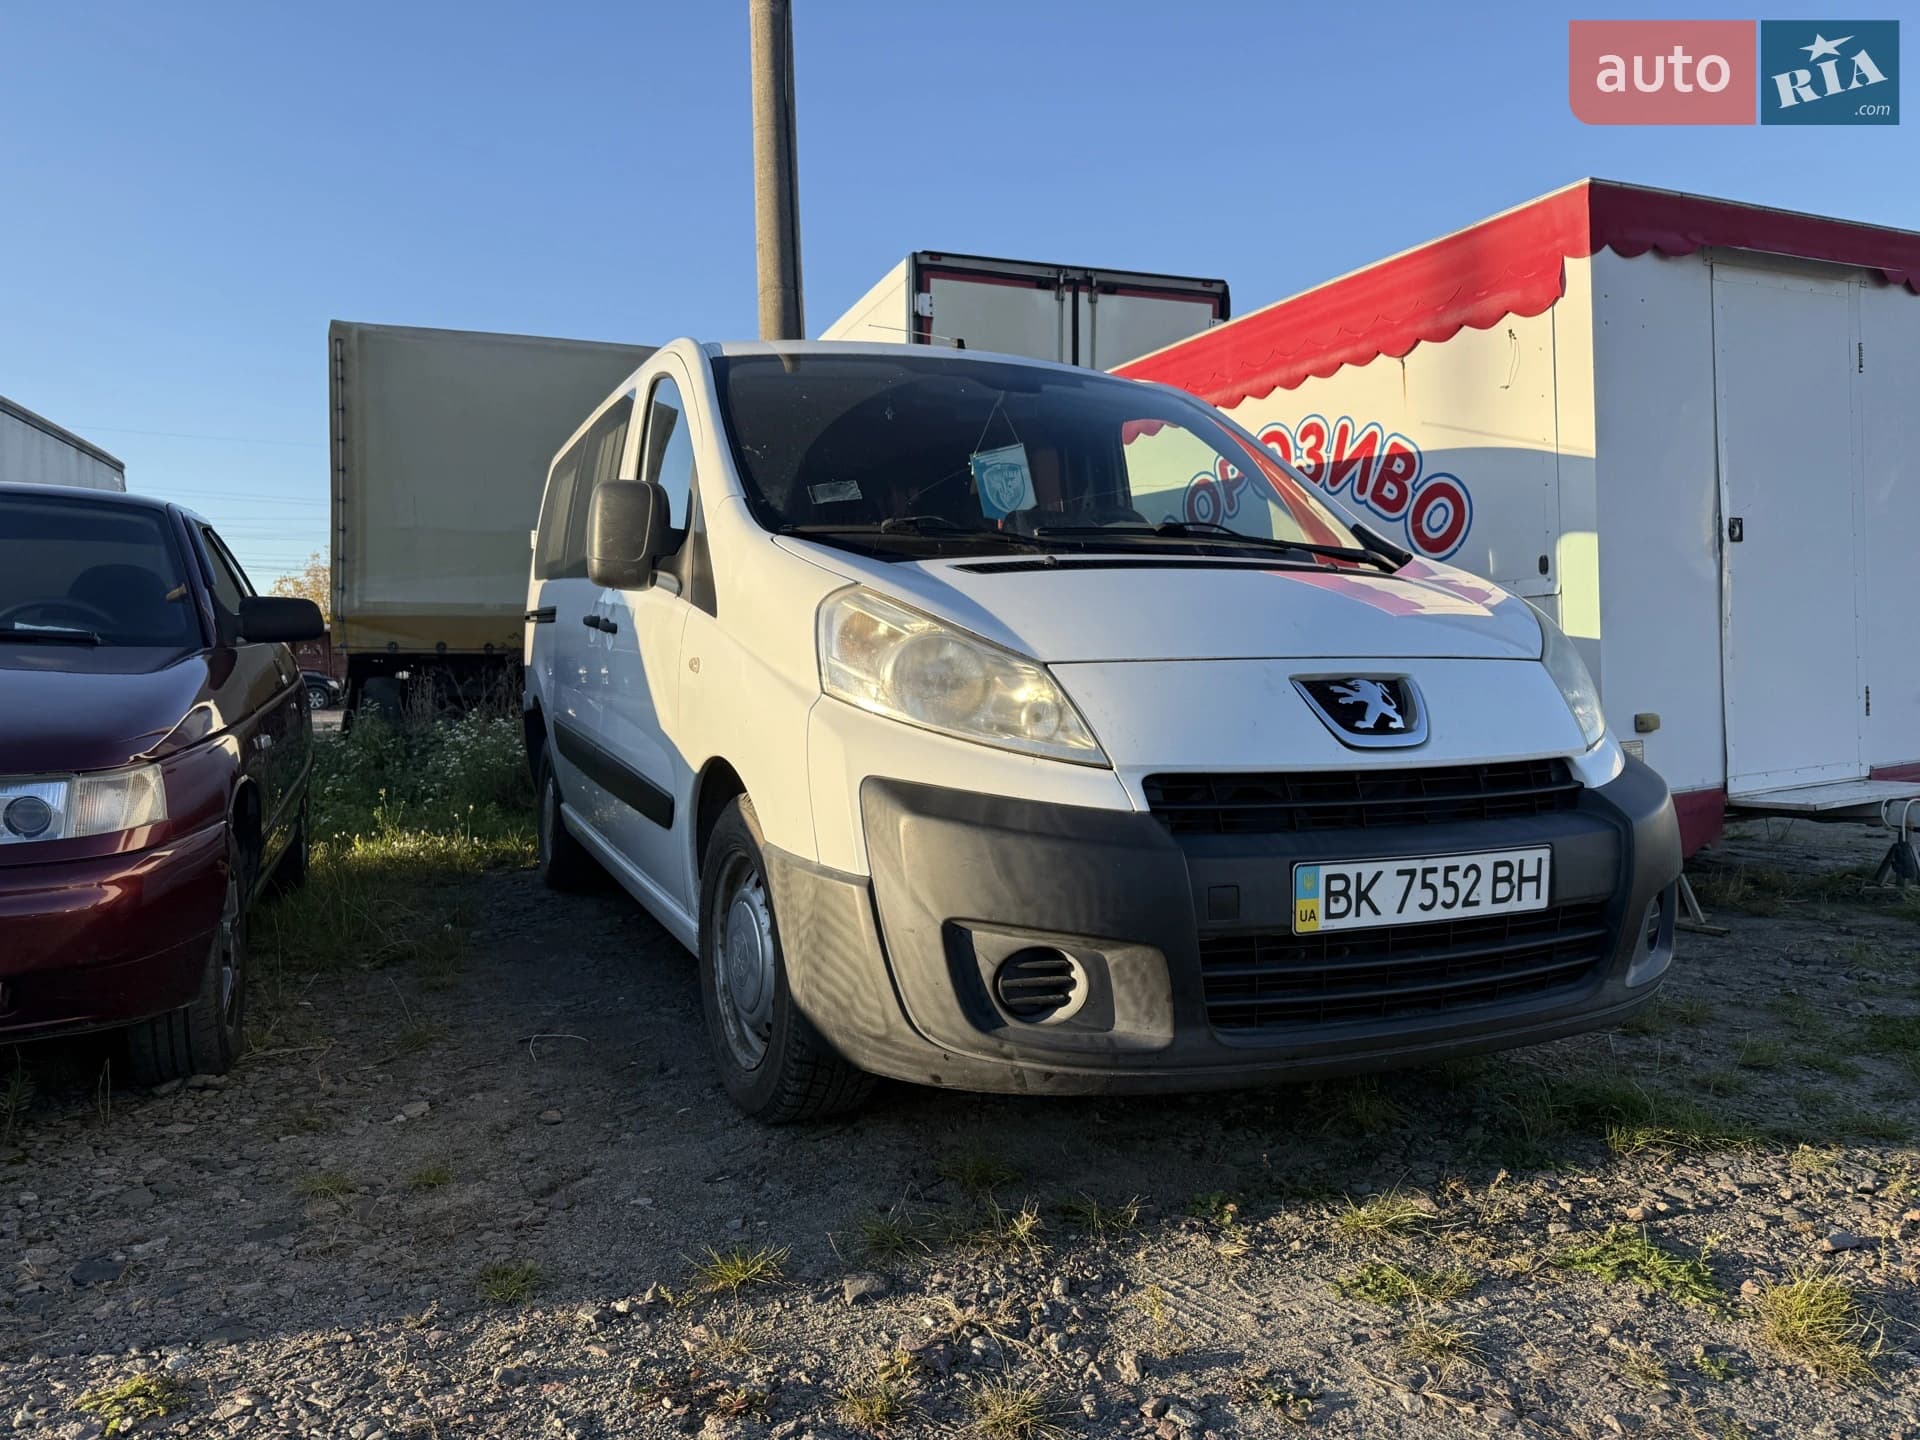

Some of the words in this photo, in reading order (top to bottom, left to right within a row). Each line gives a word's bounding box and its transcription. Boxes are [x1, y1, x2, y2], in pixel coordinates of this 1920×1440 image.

[1163, 414, 1472, 561] ОРЗИВО
[1299, 909, 1317, 922] UA
[1324, 870, 1384, 920] BK
[1396, 863, 1482, 915] 7552
[1490, 857, 1543, 905] BH
